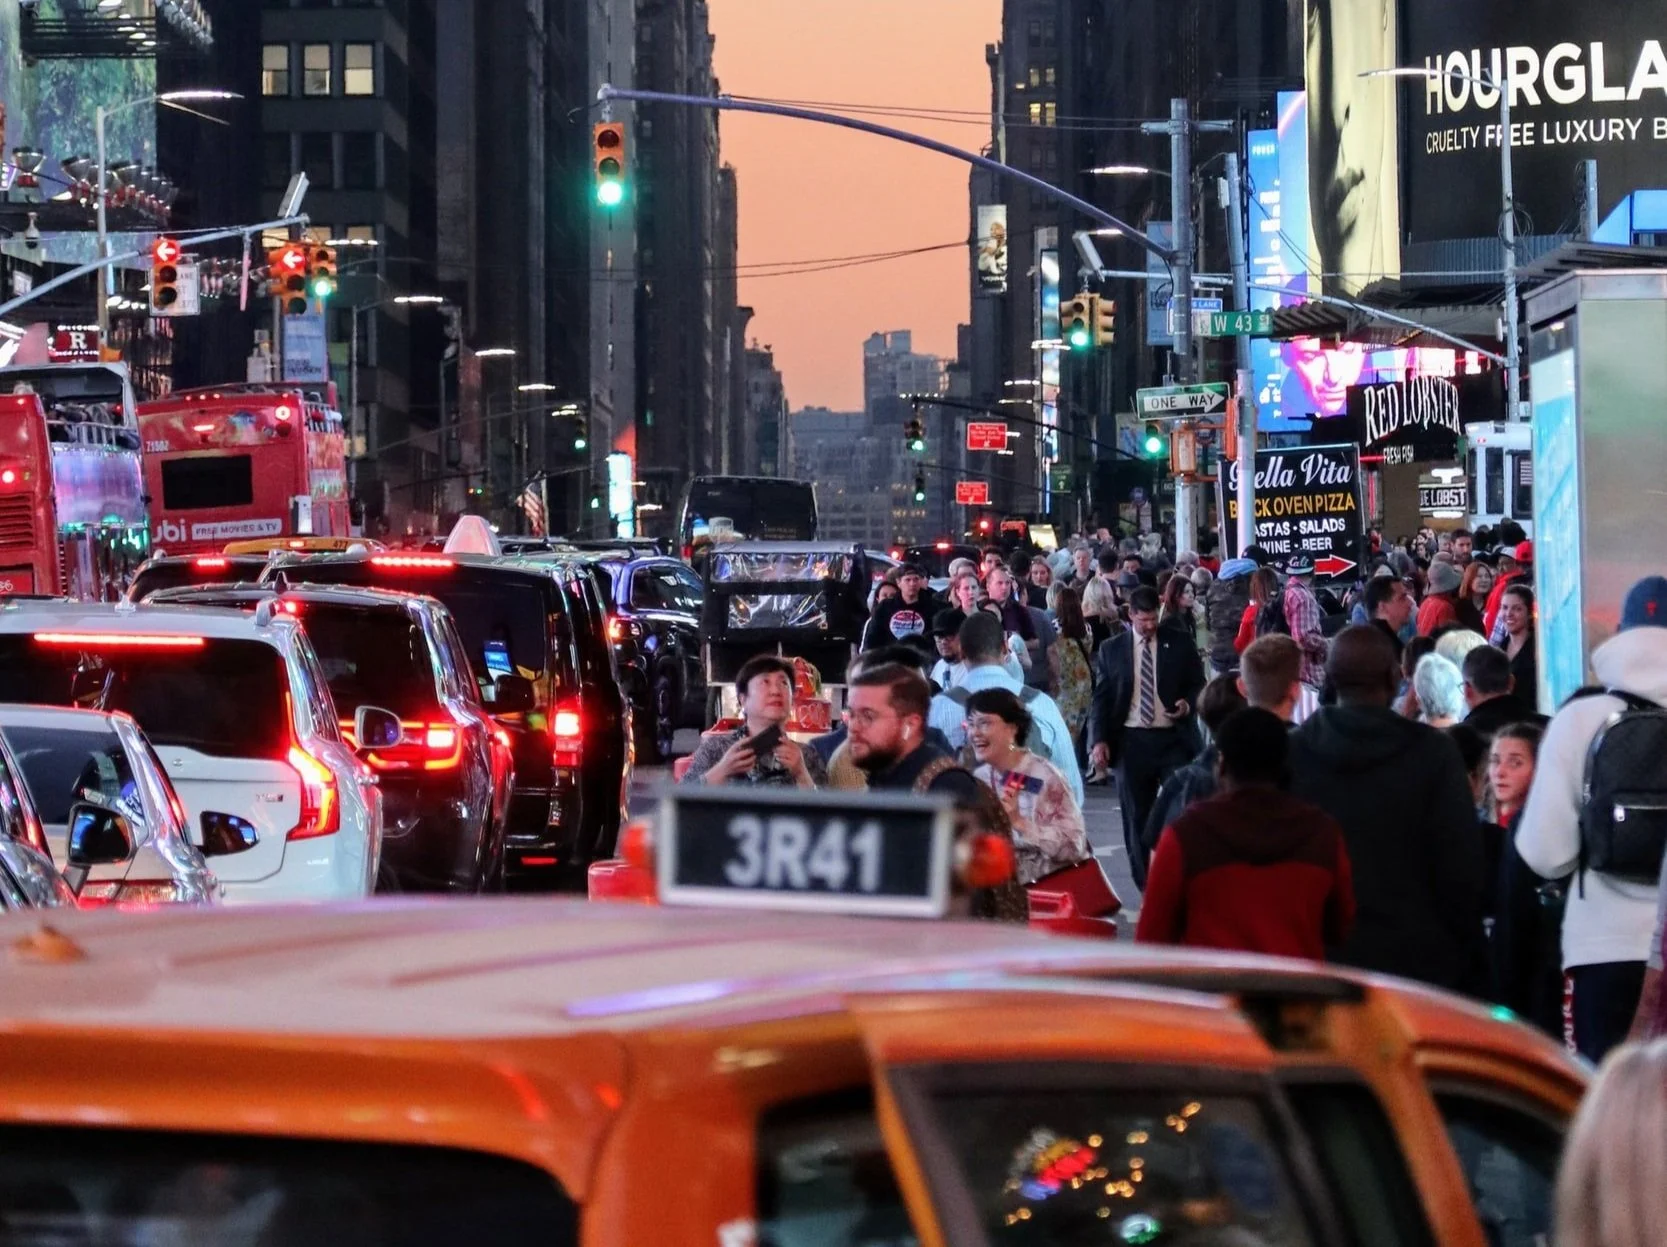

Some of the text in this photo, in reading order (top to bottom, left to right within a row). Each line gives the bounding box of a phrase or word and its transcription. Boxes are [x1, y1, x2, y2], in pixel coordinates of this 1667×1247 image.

[1425, 39, 1667, 115] HOURGLA
[1426, 126, 1480, 154] CRUELTY
[1542, 117, 1643, 145] LUXURY
[1214, 315, 1227, 332] W
[1235, 314, 1252, 332] 43
[69, 332, 88, 349] R
[1151, 393, 1215, 409] ONE WAY
[1363, 375, 1461, 447] RED LOBSTER
[1383, 447, 1401, 464] FRESH
[1300, 453, 1353, 486] Vita
[1229, 492, 1356, 519] BCK OVEN PIZZA
[195, 526, 218, 536] FREE
[221, 524, 255, 534] MOVIES
[265, 523, 278, 531] TV
[1299, 518, 1346, 535] SALADS
[1259, 537, 1333, 554] WINE BEER
[724, 813, 883, 893] 3R41
